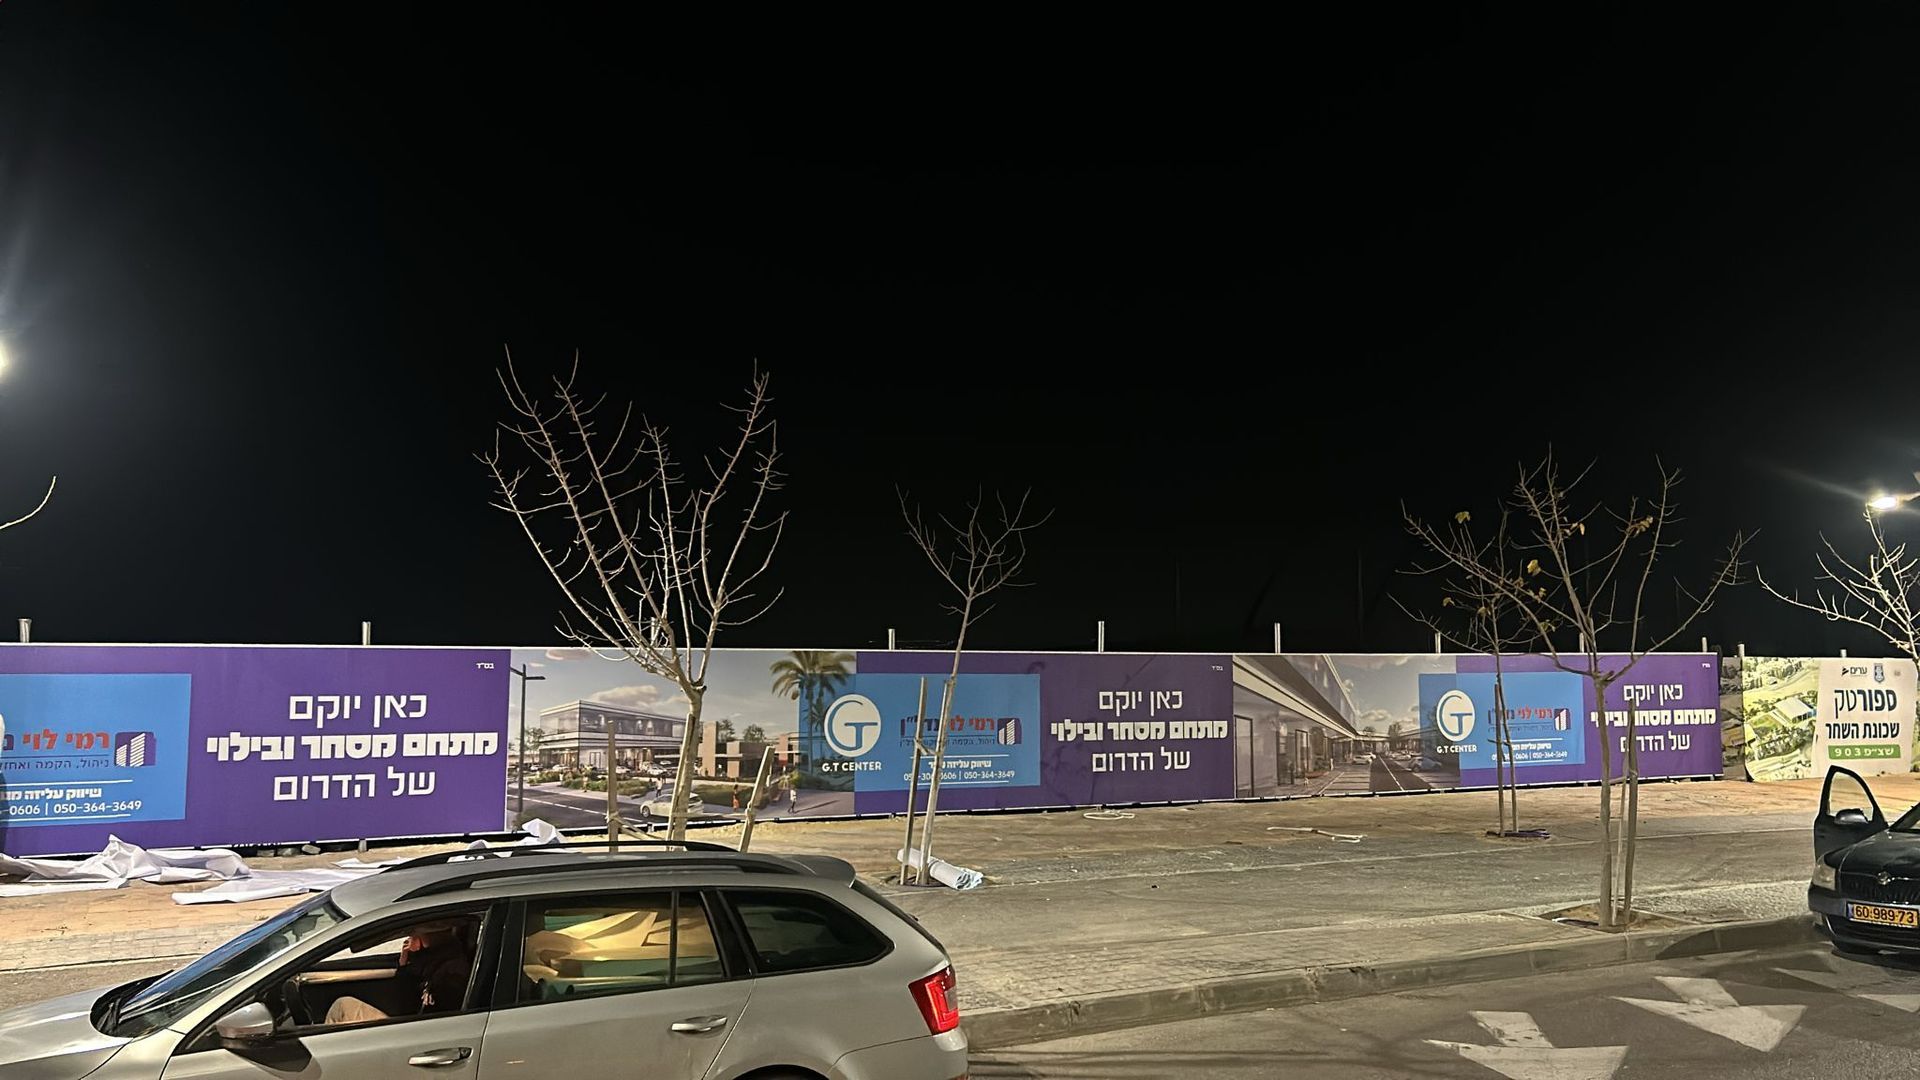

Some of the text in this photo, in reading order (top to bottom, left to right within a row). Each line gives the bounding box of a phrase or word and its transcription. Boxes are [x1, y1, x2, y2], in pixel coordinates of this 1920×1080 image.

[1099, 691, 1183, 717] כאן יוקם
[1623, 685, 1683, 707] כאן יוקם
[1834, 689, 1897, 719] ספורטק
[289, 695, 427, 729] כאן יוקם
[1674, 709, 1716, 725] מתחם
[969, 716, 995, 731] רמי
[1051, 719, 1228, 741] מתחם מסחר ובילוי
[1825, 722, 1900, 739] שכונת השחר
[22, 728, 58, 750] לוי
[65, 731, 110, 750] רמי
[207, 731, 498, 761] מתחם מסחר ובילוי
[1450, 745, 1477, 753] CENTER
[1620, 731, 1691, 752] של הדרם
[36, 760, 71, 770] הקמה
[841, 761, 882, 772] CENTER
[1092, 746, 1191, 772] של הדרום
[274, 766, 435, 801] של הדרום
[24, 788, 64, 800] עליזה
[66, 788, 102, 800] שיווק
[53, 800, 143, 814] 050-364-3649
